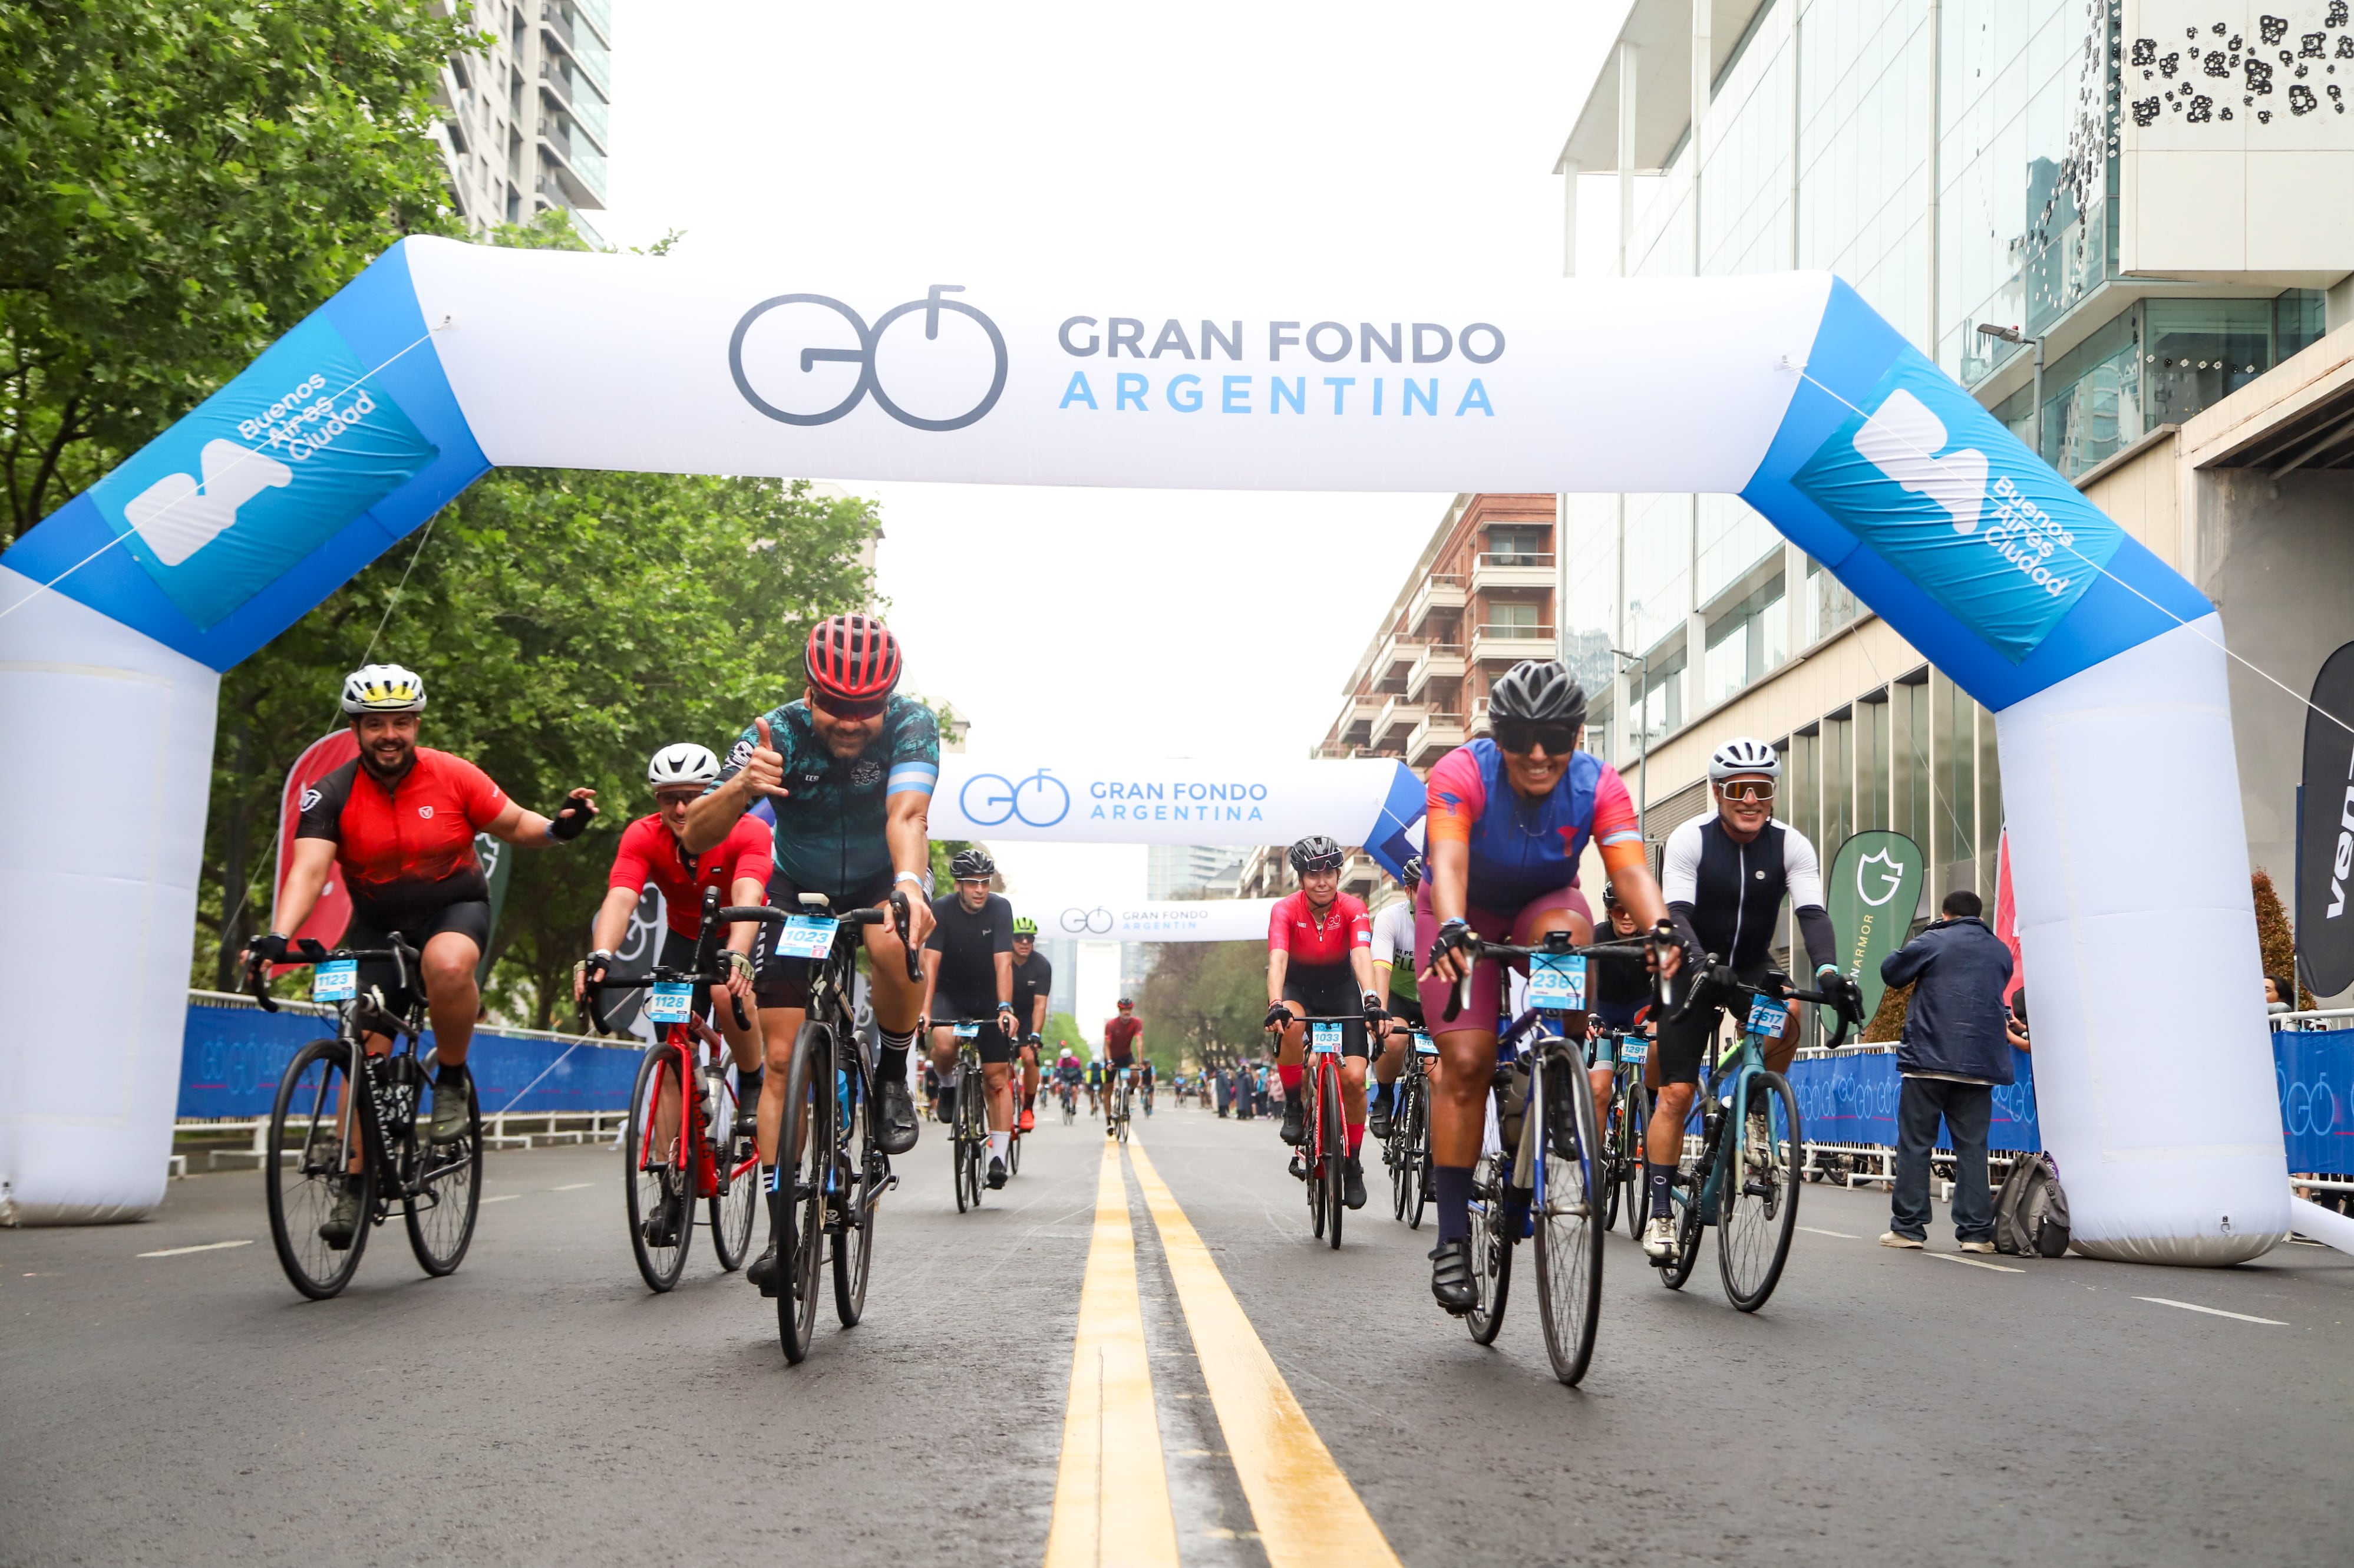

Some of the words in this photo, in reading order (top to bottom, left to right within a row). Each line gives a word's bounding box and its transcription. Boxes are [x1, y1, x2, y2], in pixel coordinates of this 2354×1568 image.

[1058, 315, 1243, 361] GRAN
[1269, 321, 1505, 364] FONDO
[1058, 371, 1495, 417] ARGENTINA
[237, 374, 326, 440] Buenos
[268, 397, 334, 449] Aires
[288, 389, 377, 460] Ciudad
[1993, 476, 2075, 547] Buenos
[1990, 504, 2054, 557] Aires
[1985, 526, 2070, 597] Ciudad
[1090, 782, 1163, 800] GRAN
[1174, 783, 1267, 800] FONDO
[1091, 804, 1263, 821] ARGENTINA
[1122, 912, 1158, 920] GRAN
[1163, 910, 1208, 919] FONDO
[785, 930, 829, 943] 1023
[1850, 915, 1874, 985] NARMOR
[318, 974, 349, 986] 1123
[1533, 973, 1583, 990] 2360
[655, 996, 685, 1008] 1128
[1752, 1009, 1783, 1024] 2617
[1315, 1034, 1339, 1042] 1033
[1625, 1046, 1645, 1054] 1291
